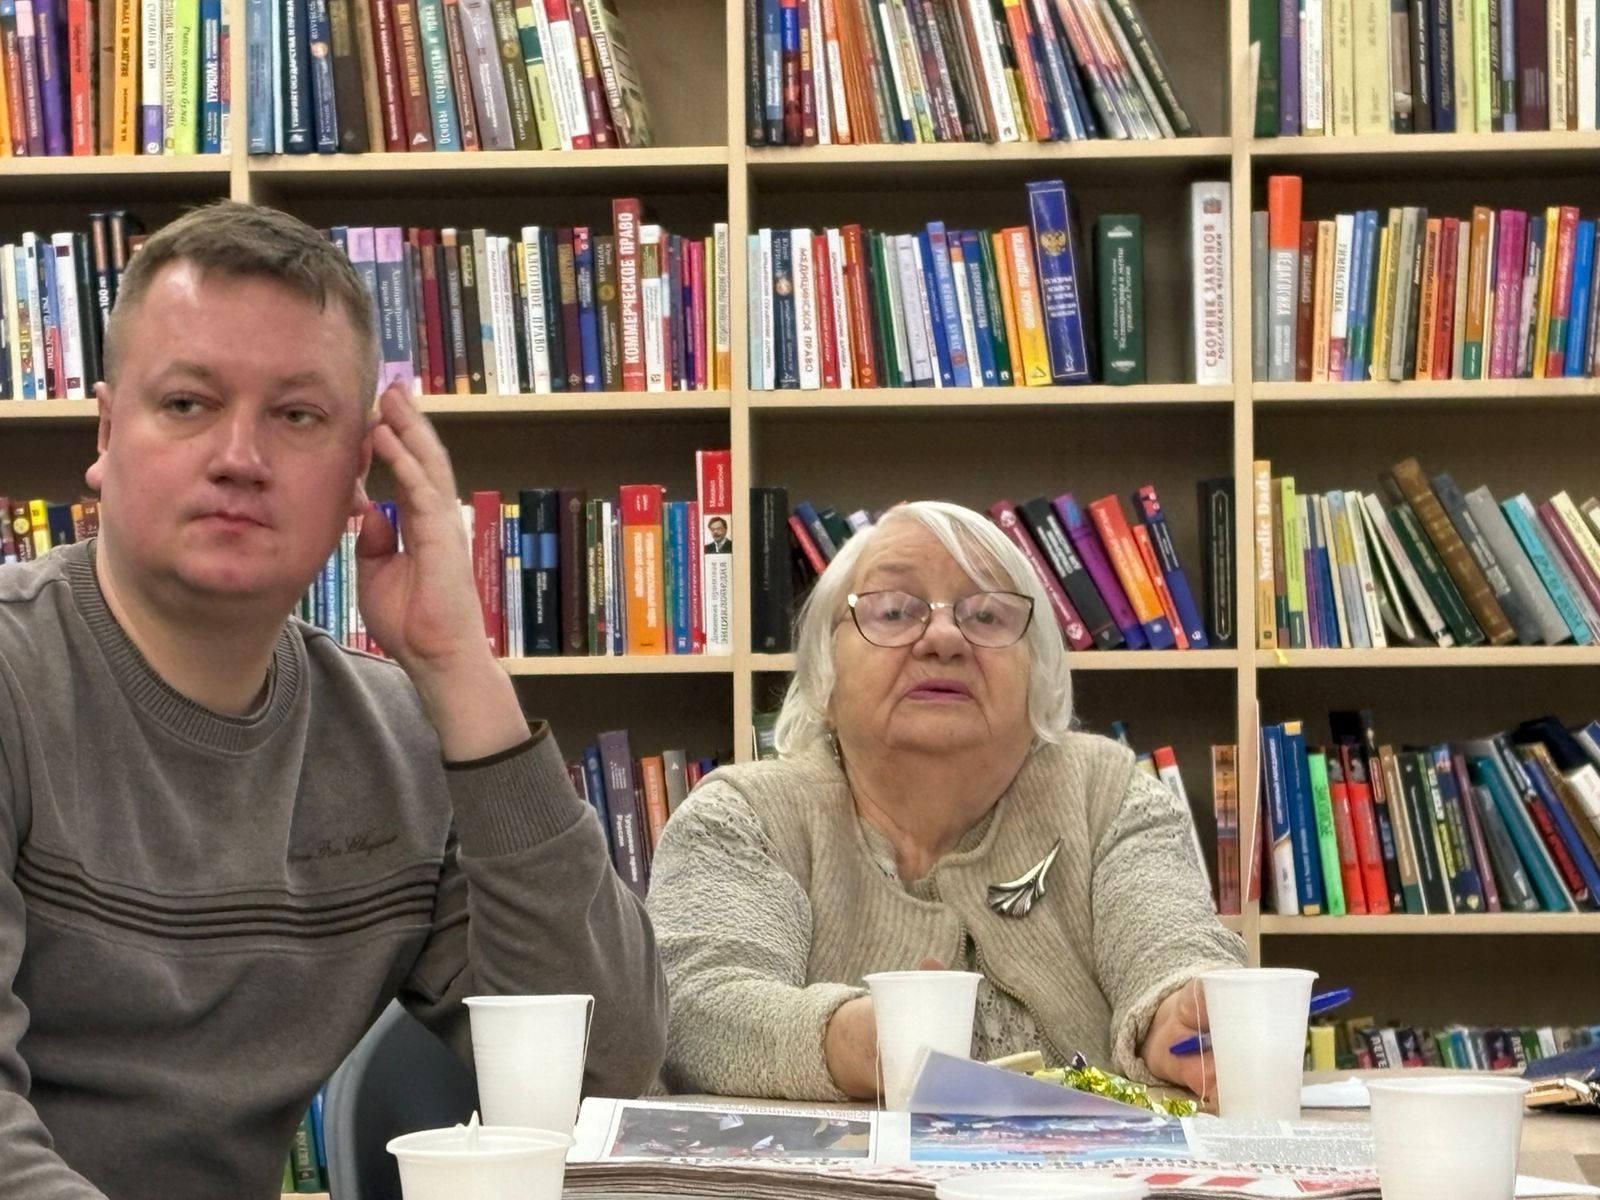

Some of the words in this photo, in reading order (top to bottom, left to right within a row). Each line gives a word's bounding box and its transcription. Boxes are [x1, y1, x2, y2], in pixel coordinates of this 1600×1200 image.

[147, 3, 157, 38] СТАРТАП
[181, 26, 190, 56] Рынок
[121, 36, 130, 77] ВВЕДЕНИЕ
[181, 58, 190, 95] ценных
[180, 98, 191, 127] бумаг
[617, 212, 635, 255] ПРАВО
[526, 242, 543, 310] НАЛОГОВОЕ
[1202, 224, 1216, 294] ЗАКОНОВ
[1334, 243, 1348, 313] ГИМНАСТИКА
[98, 289, 109, 308] 100
[799, 248, 812, 331] МЕДИЦИНСКОЕ
[1276, 252, 1291, 315] ПЕДАГОГИКА
[620, 259, 640, 364] КОММЕРЧЕСКОЕ
[1203, 299, 1217, 367] СБОРНИК
[1216, 293, 1225, 360] РОССИЙСКОЙ
[533, 316, 546, 353] ПРАВО
[804, 336, 814, 373] ПРАВО
[1255, 471, 1269, 515] Dads
[1258, 522, 1273, 581] Nordic
[616, 815, 625, 847] России
[629, 855, 638, 882] право
